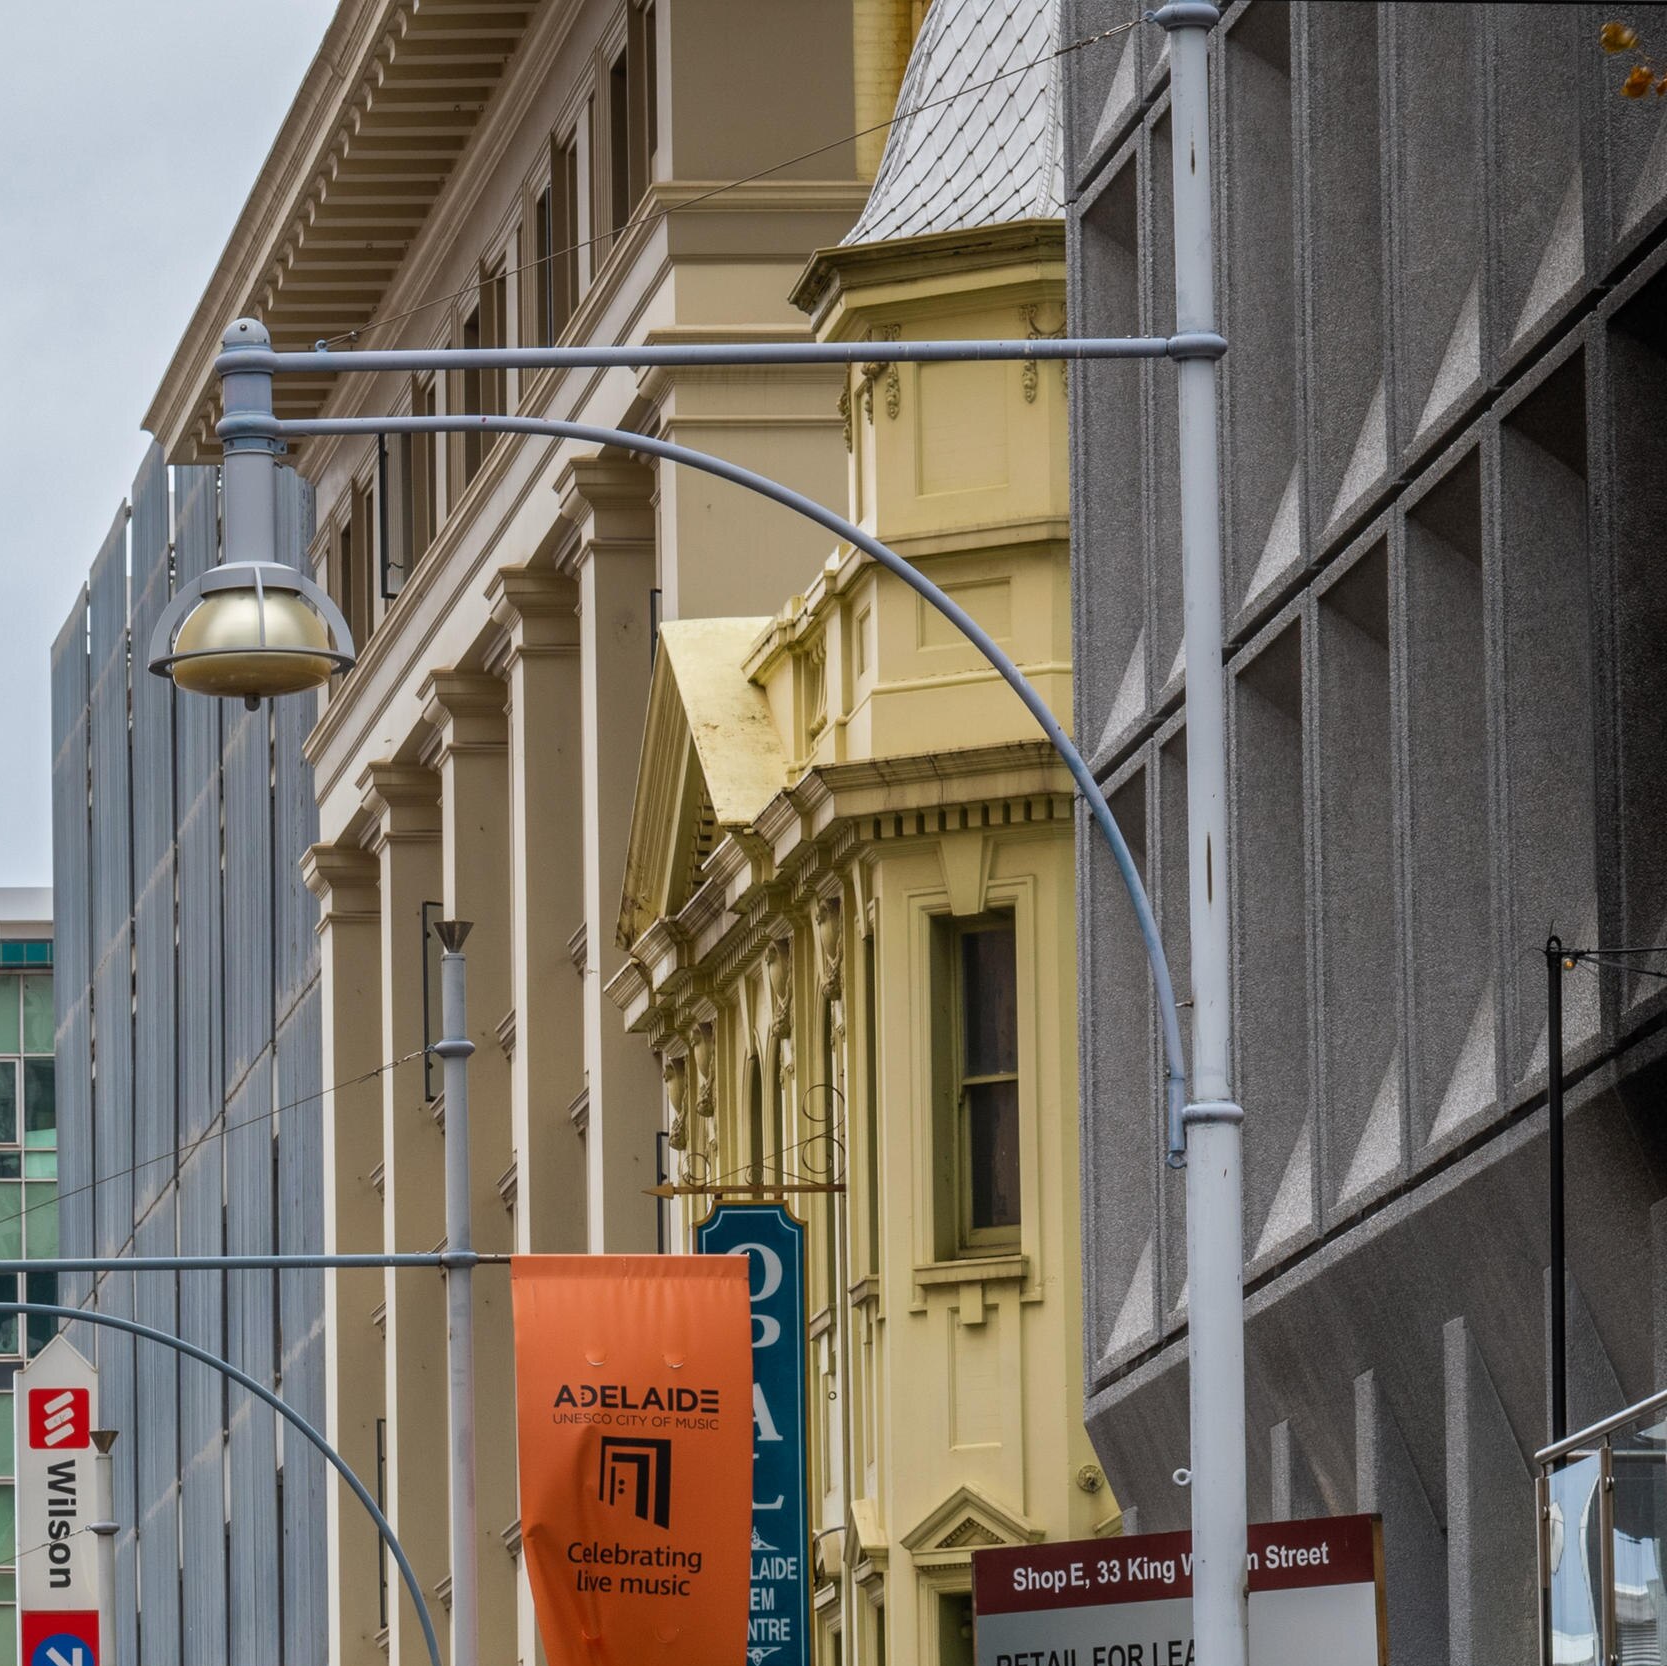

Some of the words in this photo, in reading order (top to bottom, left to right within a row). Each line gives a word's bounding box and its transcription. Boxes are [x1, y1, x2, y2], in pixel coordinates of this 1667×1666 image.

[553, 1385, 719, 1414] ADELAIDE
[553, 1413, 612, 1425] UNESCO
[617, 1414, 647, 1427] CITY
[651, 1416, 671, 1427] OF
[676, 1417, 719, 1430] MUSIC
[47, 1459, 76, 1589] Wilson
[567, 1542, 702, 1574] Celebrating
[1013, 1565, 1067, 1593] Shop
[1097, 1559, 1121, 1583] 33
[1127, 1557, 1175, 1583] King
[1265, 1542, 1329, 1569] Street
[577, 1569, 612, 1592] live
[620, 1574, 691, 1596] music
